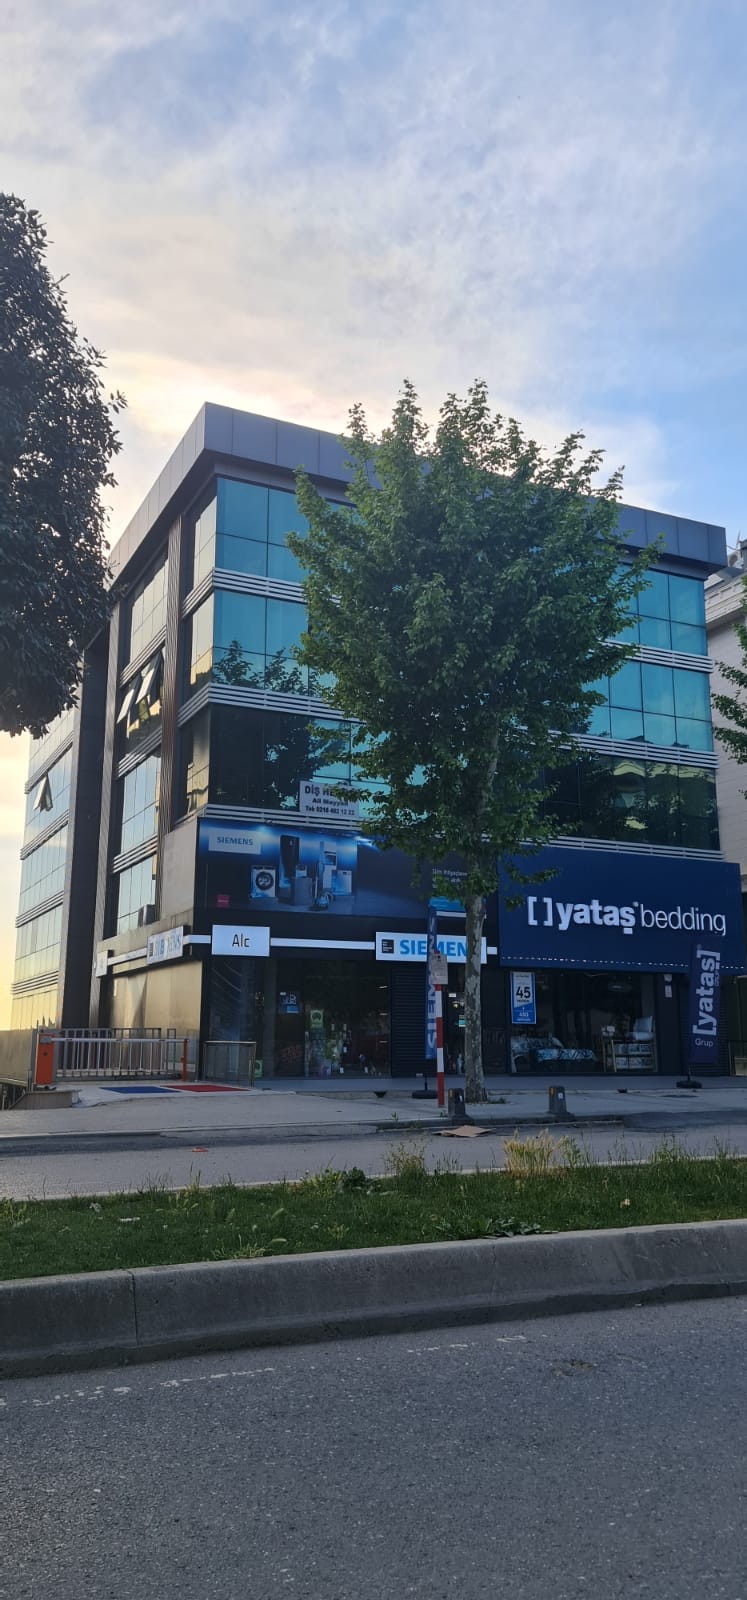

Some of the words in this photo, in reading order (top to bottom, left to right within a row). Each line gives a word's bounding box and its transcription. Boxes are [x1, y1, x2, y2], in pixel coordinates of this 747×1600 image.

[216, 836, 253, 846] SIEMENS
[640, 902, 727, 936] bedding
[400, 939, 468, 958] SIEMEN
[516, 986, 531, 999] 45
